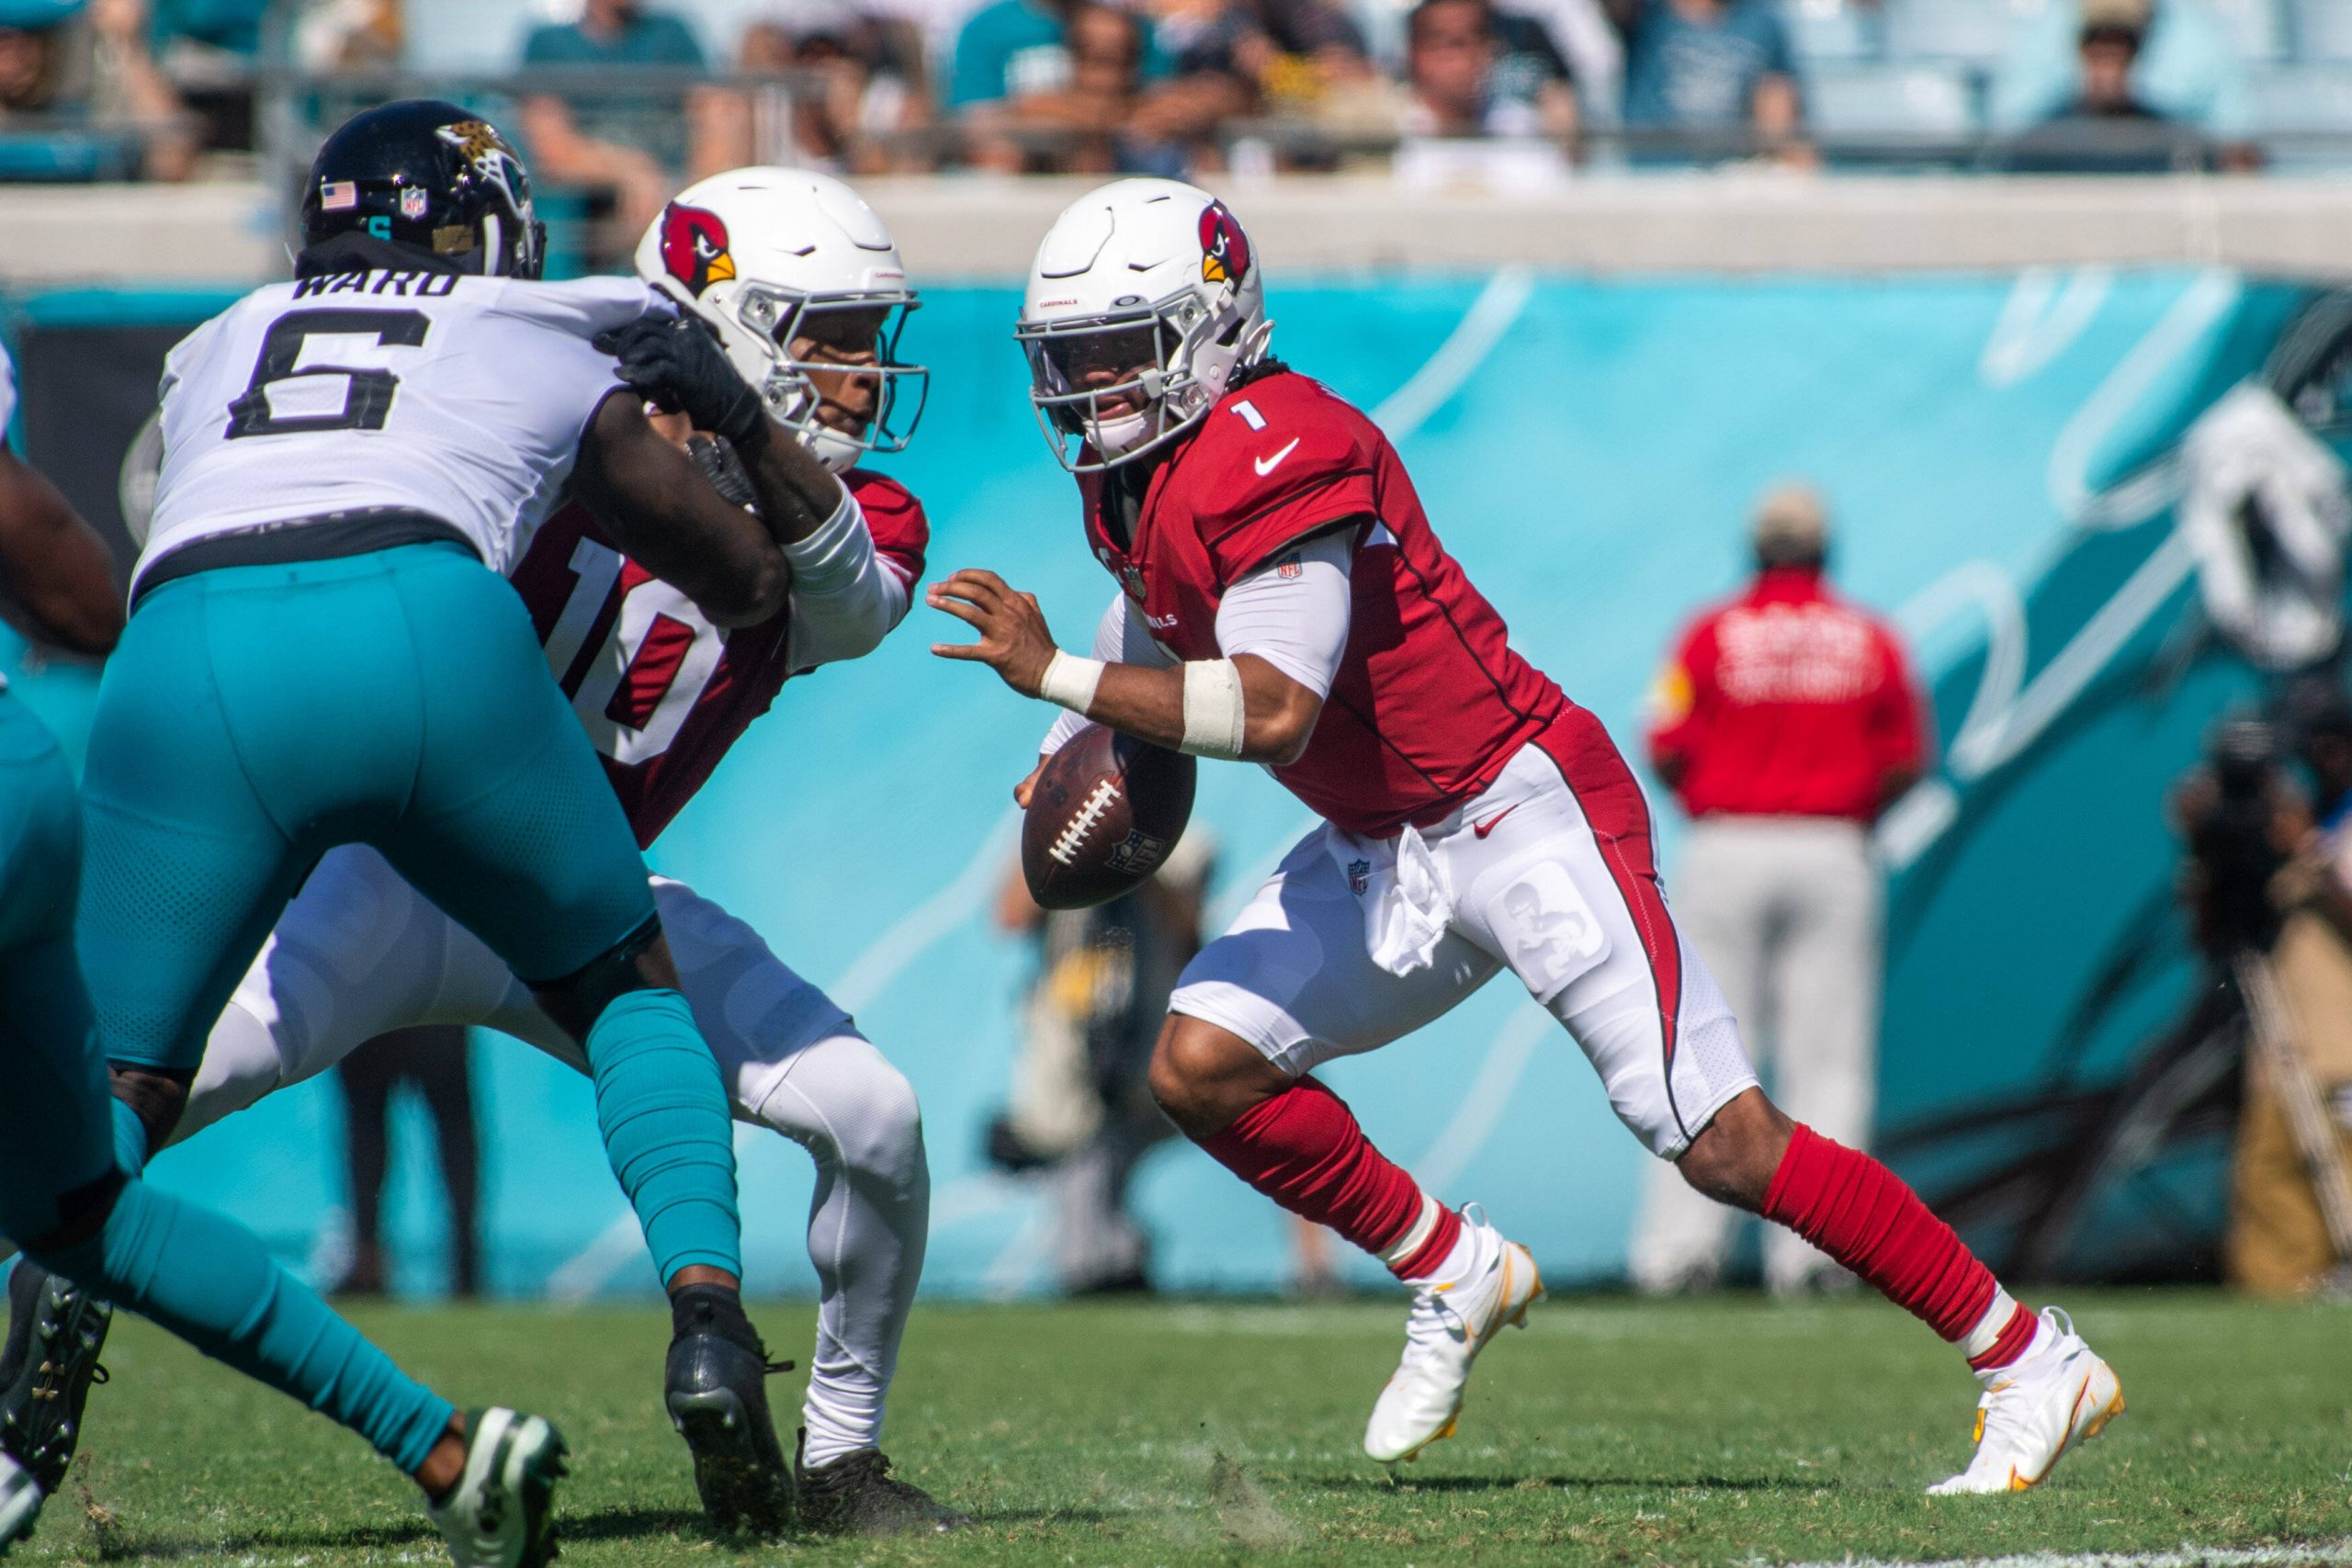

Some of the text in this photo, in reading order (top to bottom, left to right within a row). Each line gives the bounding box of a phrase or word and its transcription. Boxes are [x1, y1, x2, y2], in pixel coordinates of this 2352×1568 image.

[291, 269, 461, 299] WARD
[1039, 299, 1078, 308] CARDINALS
[223, 307, 432, 440] 6
[1229, 400, 1268, 432] 1
[544, 535, 724, 765] 10
